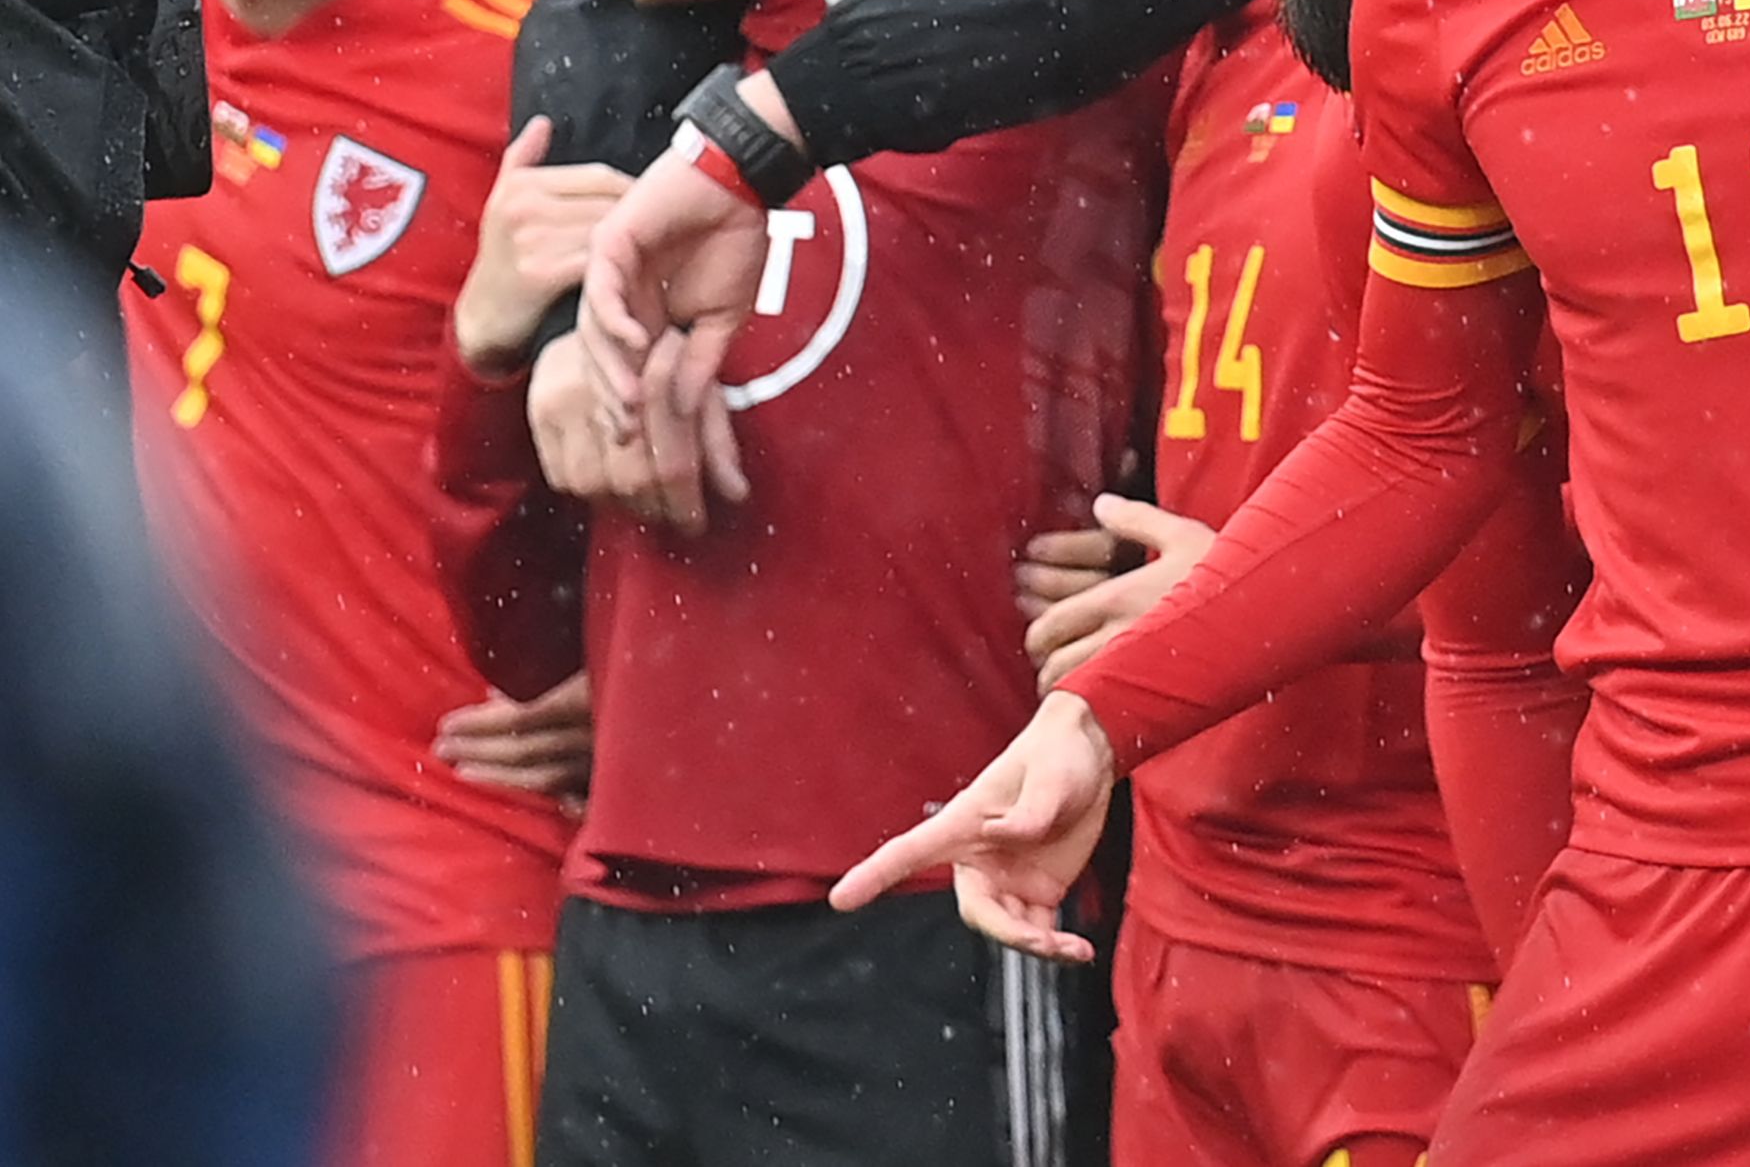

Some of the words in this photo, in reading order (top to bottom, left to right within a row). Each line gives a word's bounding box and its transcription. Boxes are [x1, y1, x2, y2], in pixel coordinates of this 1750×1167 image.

[1521, 41, 1606, 76] adidas
[171, 243, 231, 429] 7
[1164, 244, 1265, 442] 14
